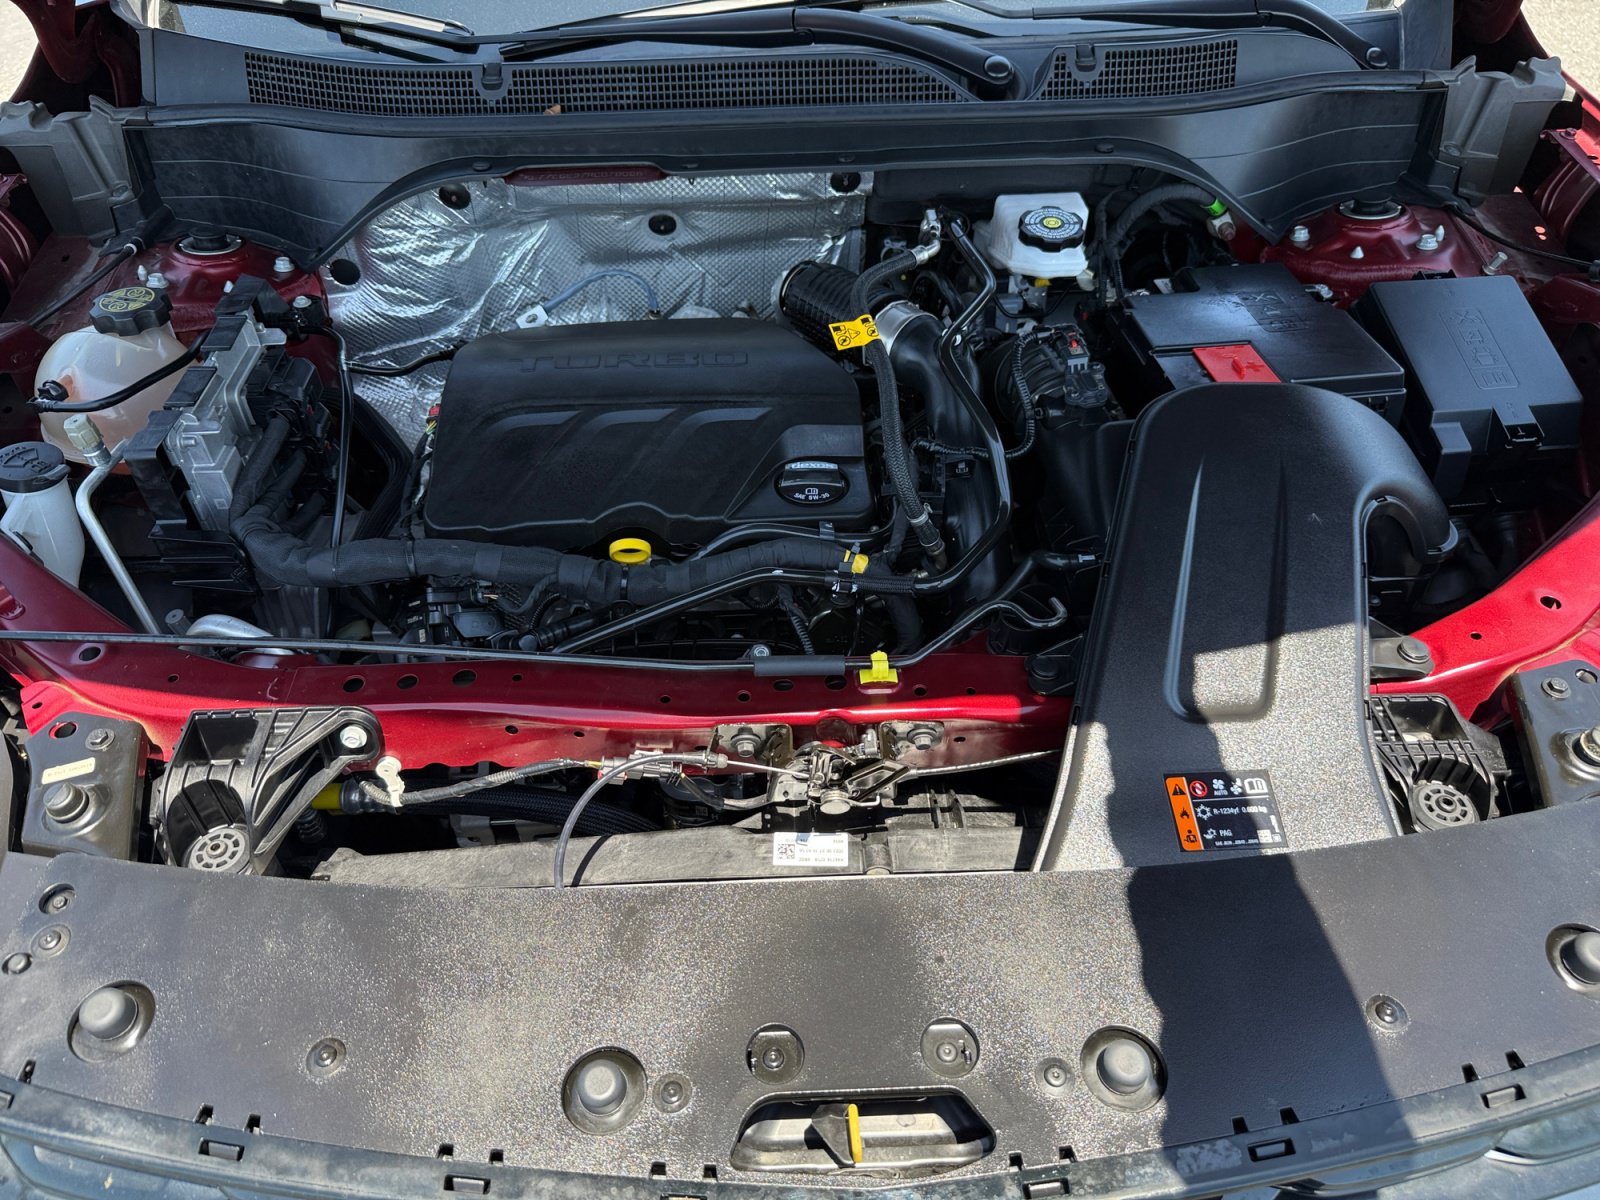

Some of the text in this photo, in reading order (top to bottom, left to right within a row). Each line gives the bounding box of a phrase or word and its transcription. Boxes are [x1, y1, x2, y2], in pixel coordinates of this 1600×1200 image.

[508, 352, 749, 373] TURBO
[791, 461, 834, 469] dexos
[793, 492, 806, 500] SAE
[1212, 807, 1240, 815] R-1234yf
[1219, 829, 1233, 837] PAG
